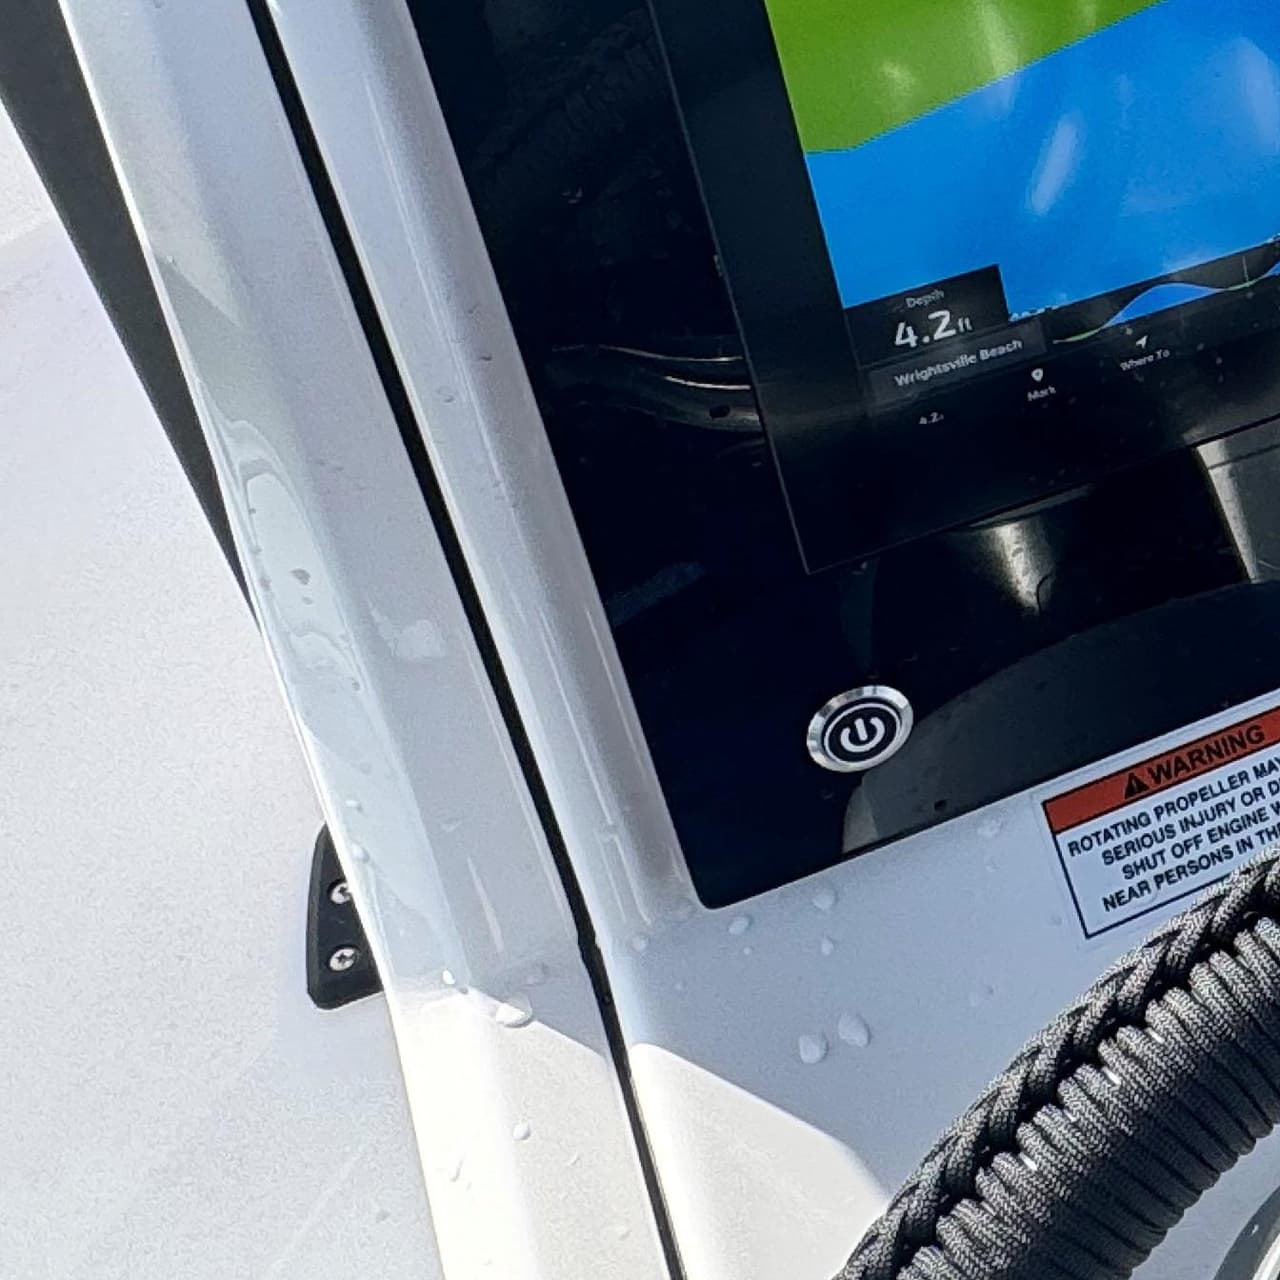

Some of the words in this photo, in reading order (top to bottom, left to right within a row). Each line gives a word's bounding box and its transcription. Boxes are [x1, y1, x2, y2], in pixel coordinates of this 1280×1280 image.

[905, 288, 945, 309] Depth
[894, 352, 978, 387] Wrightsville
[980, 338, 1023, 362] Beach
[1148, 724, 1266, 786] WARNING
[1068, 811, 1153, 857] ROTATING
[1153, 771, 1251, 821] PROPELLER
[1101, 823, 1177, 866] SERIOUS
[1179, 799, 1236, 835] INJURY
[1240, 787, 1266, 808] OR
[1122, 849, 1168, 881] SHUT
[1171, 835, 1205, 861] OFF
[1207, 807, 1268, 846] ENGINE
[1102, 879, 1153, 912] NEAR
[1154, 847, 1235, 892] PERSONS
[1236, 837, 1255, 856] IN
